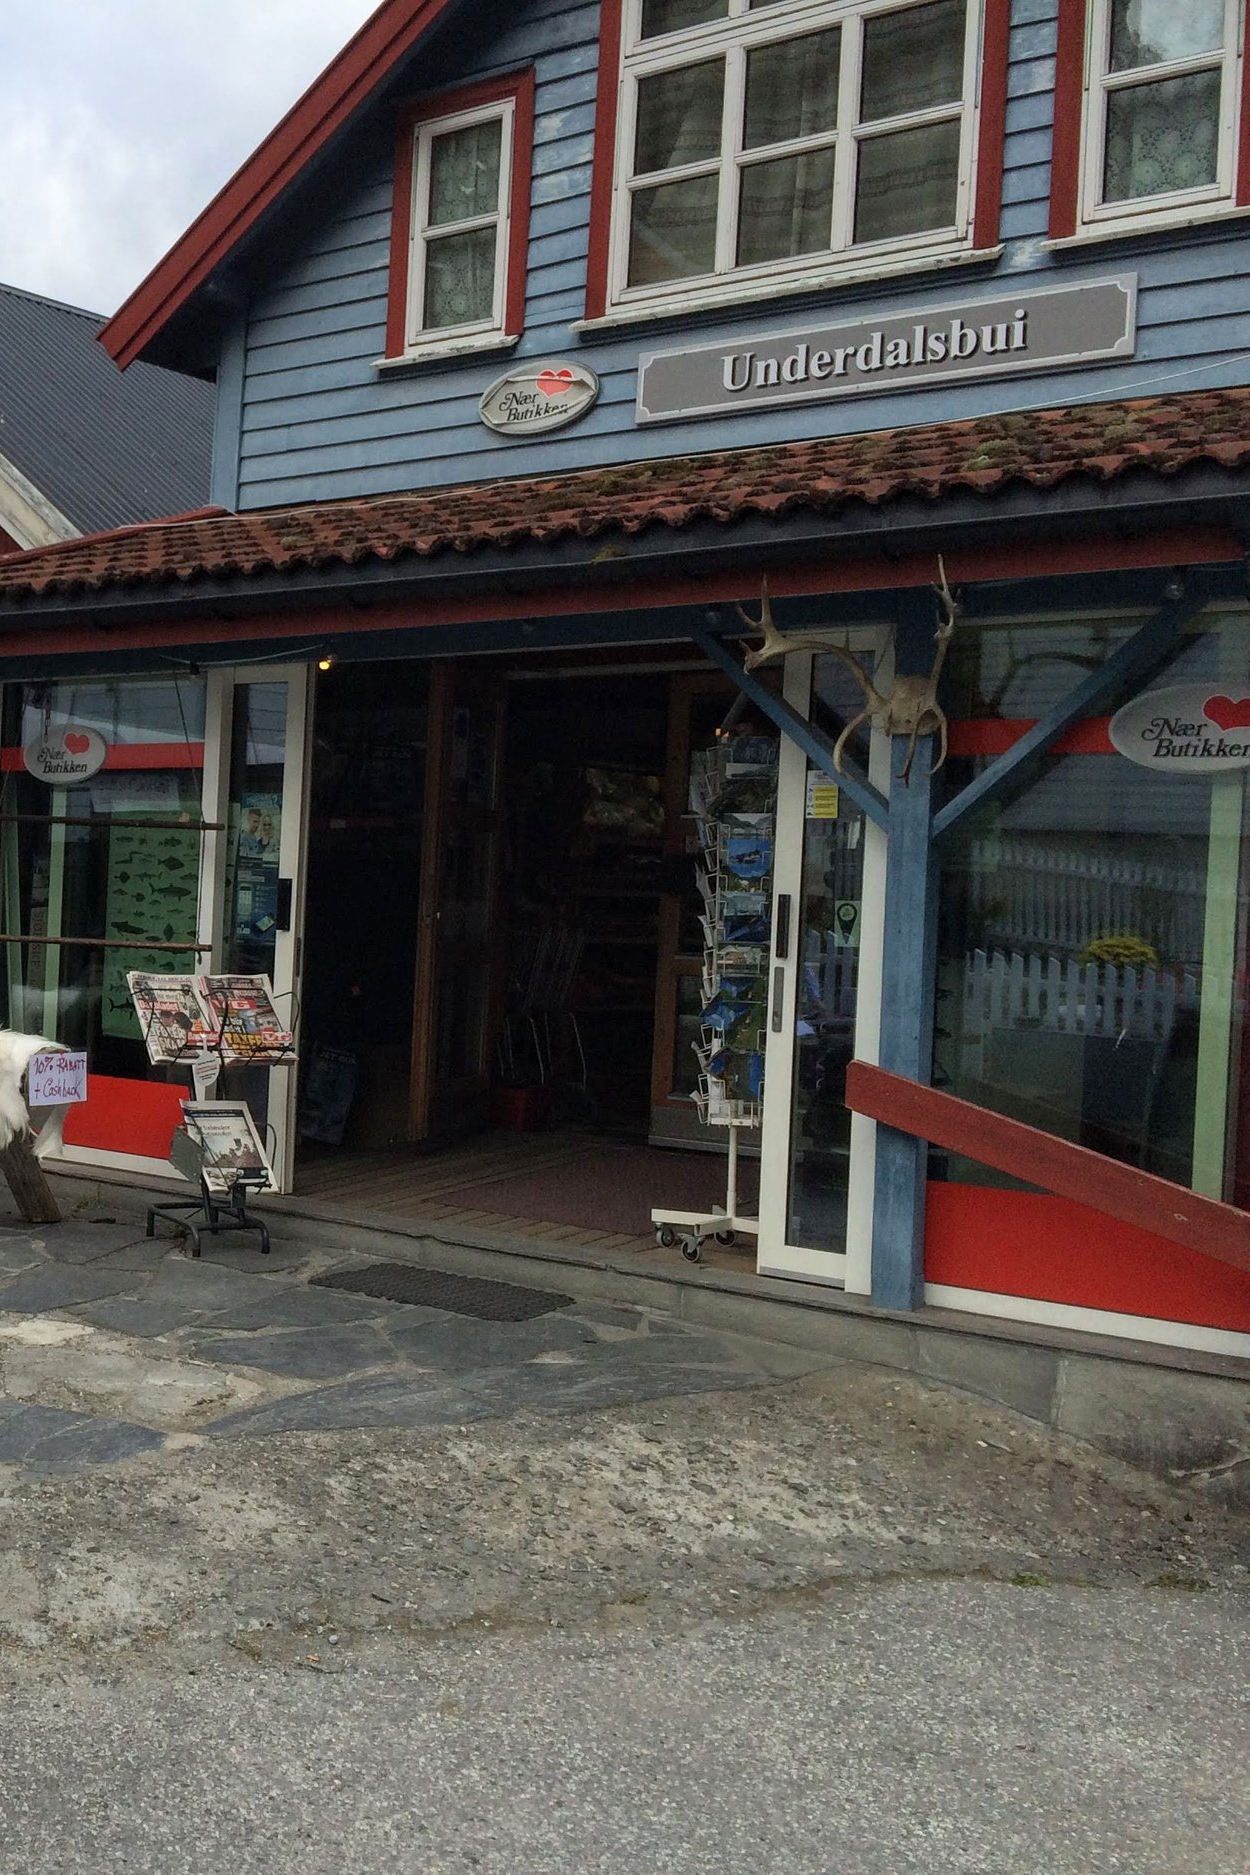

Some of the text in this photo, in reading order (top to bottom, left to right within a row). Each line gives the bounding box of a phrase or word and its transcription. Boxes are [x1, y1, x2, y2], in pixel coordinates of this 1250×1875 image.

[720, 308, 1027, 392] Underdalsbui
[498, 390, 540, 412] Nær
[1140, 717, 1208, 741] Nær
[36, 746, 66, 763] Nær
[42, 760, 88, 774] Butikken
